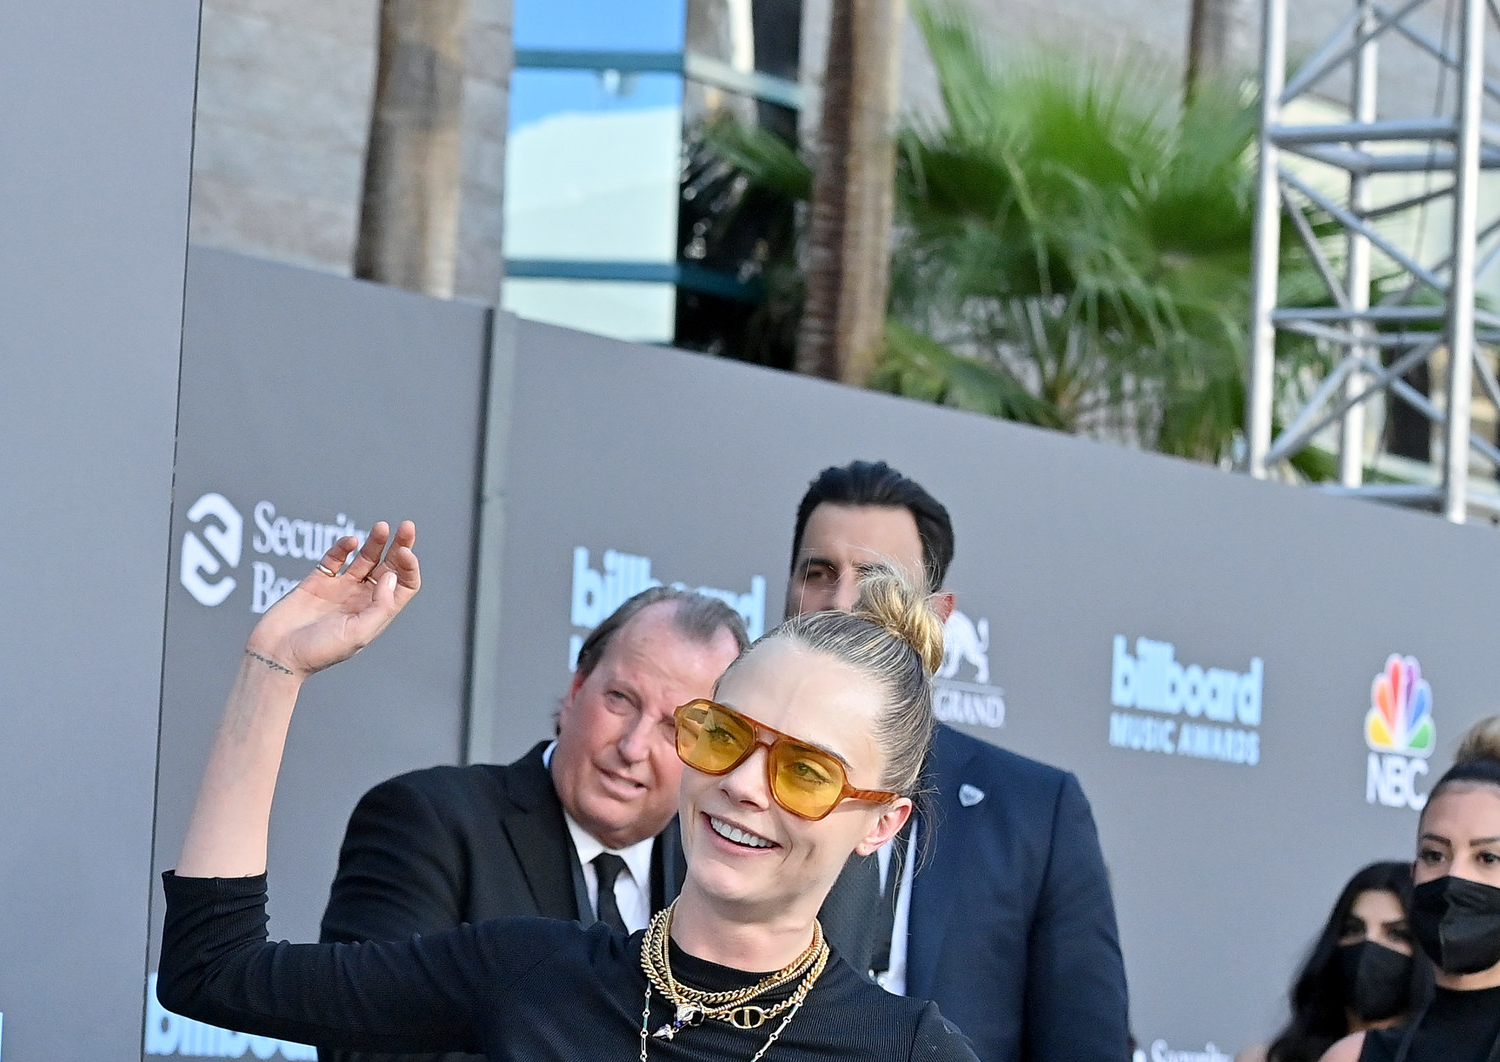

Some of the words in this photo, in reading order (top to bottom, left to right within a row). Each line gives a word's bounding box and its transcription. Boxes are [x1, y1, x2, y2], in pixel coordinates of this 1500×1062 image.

[1111, 634, 1263, 727] billboard
[1109, 711, 1176, 754] MUSIC
[1177, 722, 1260, 766] AWARDS
[1366, 752, 1428, 811] NBC
